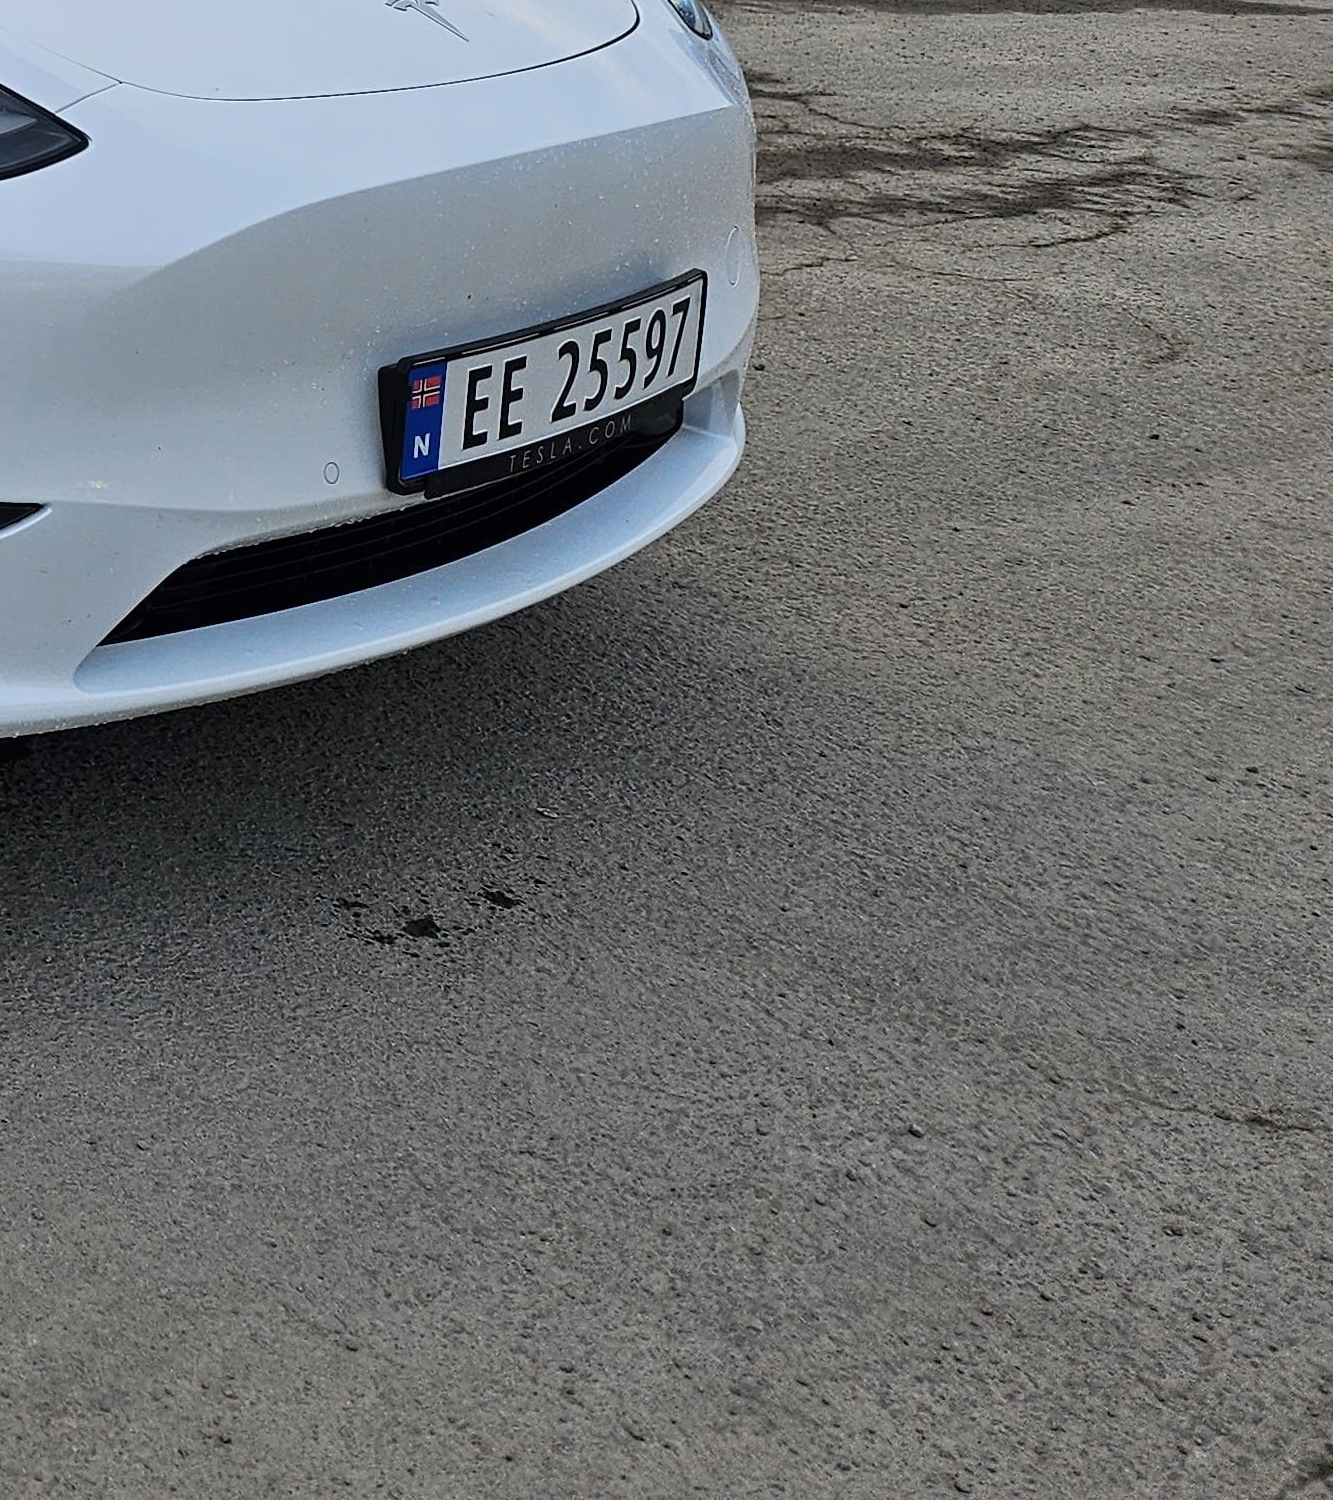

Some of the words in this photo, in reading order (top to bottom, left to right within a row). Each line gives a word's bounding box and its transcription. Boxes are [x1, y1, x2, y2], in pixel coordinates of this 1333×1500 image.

[461, 354, 529, 450] EE
[550, 296, 692, 422] 25597
[412, 432, 430, 458] N
[508, 413, 634, 474] TESLA.COM
